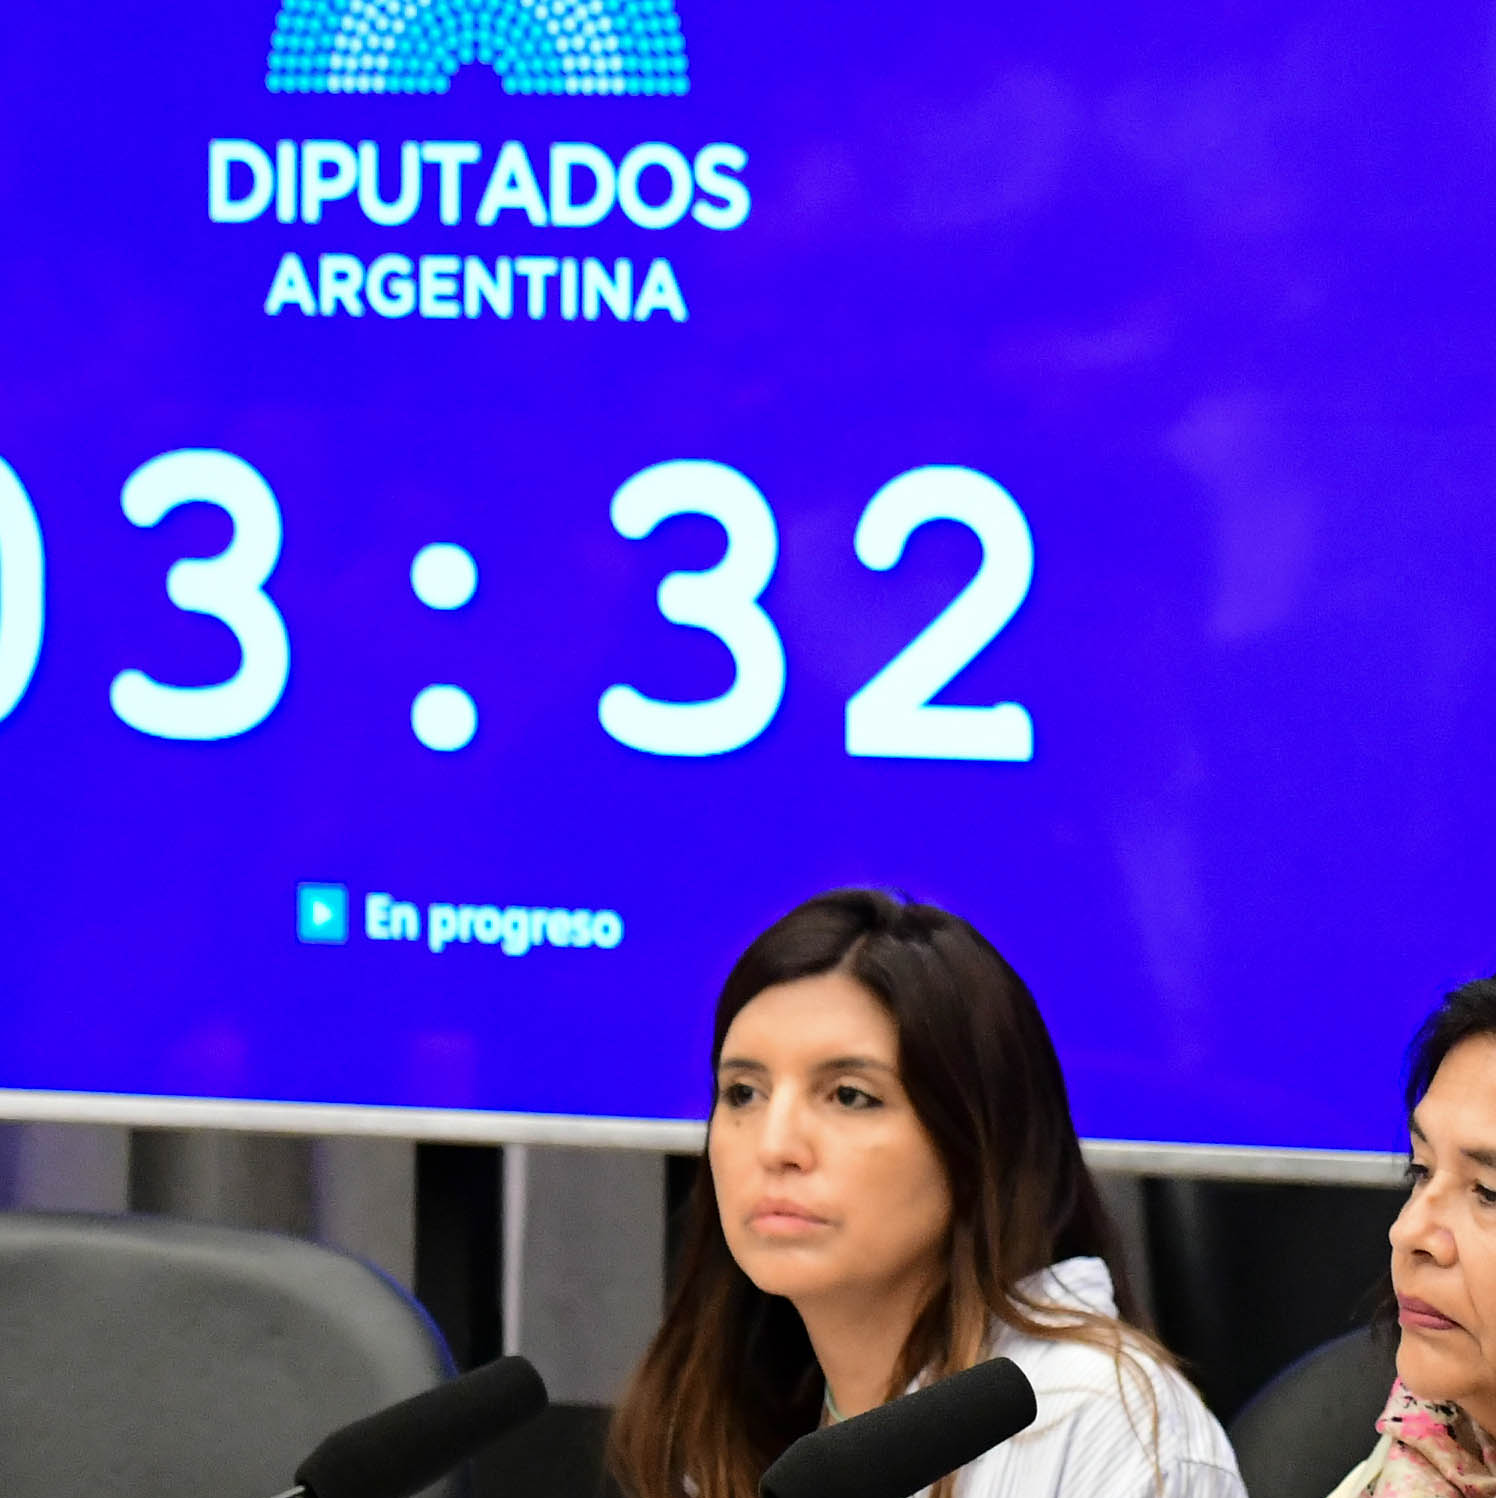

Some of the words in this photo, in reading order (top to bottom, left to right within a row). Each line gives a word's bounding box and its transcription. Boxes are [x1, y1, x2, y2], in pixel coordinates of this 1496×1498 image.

[208, 138, 752, 231] DIPUTADOS
[265, 252, 689, 323] ARGENTINA
[0, 447, 1036, 762] 3:32
[364, 891, 421, 942] En
[427, 902, 624, 957] progreso
